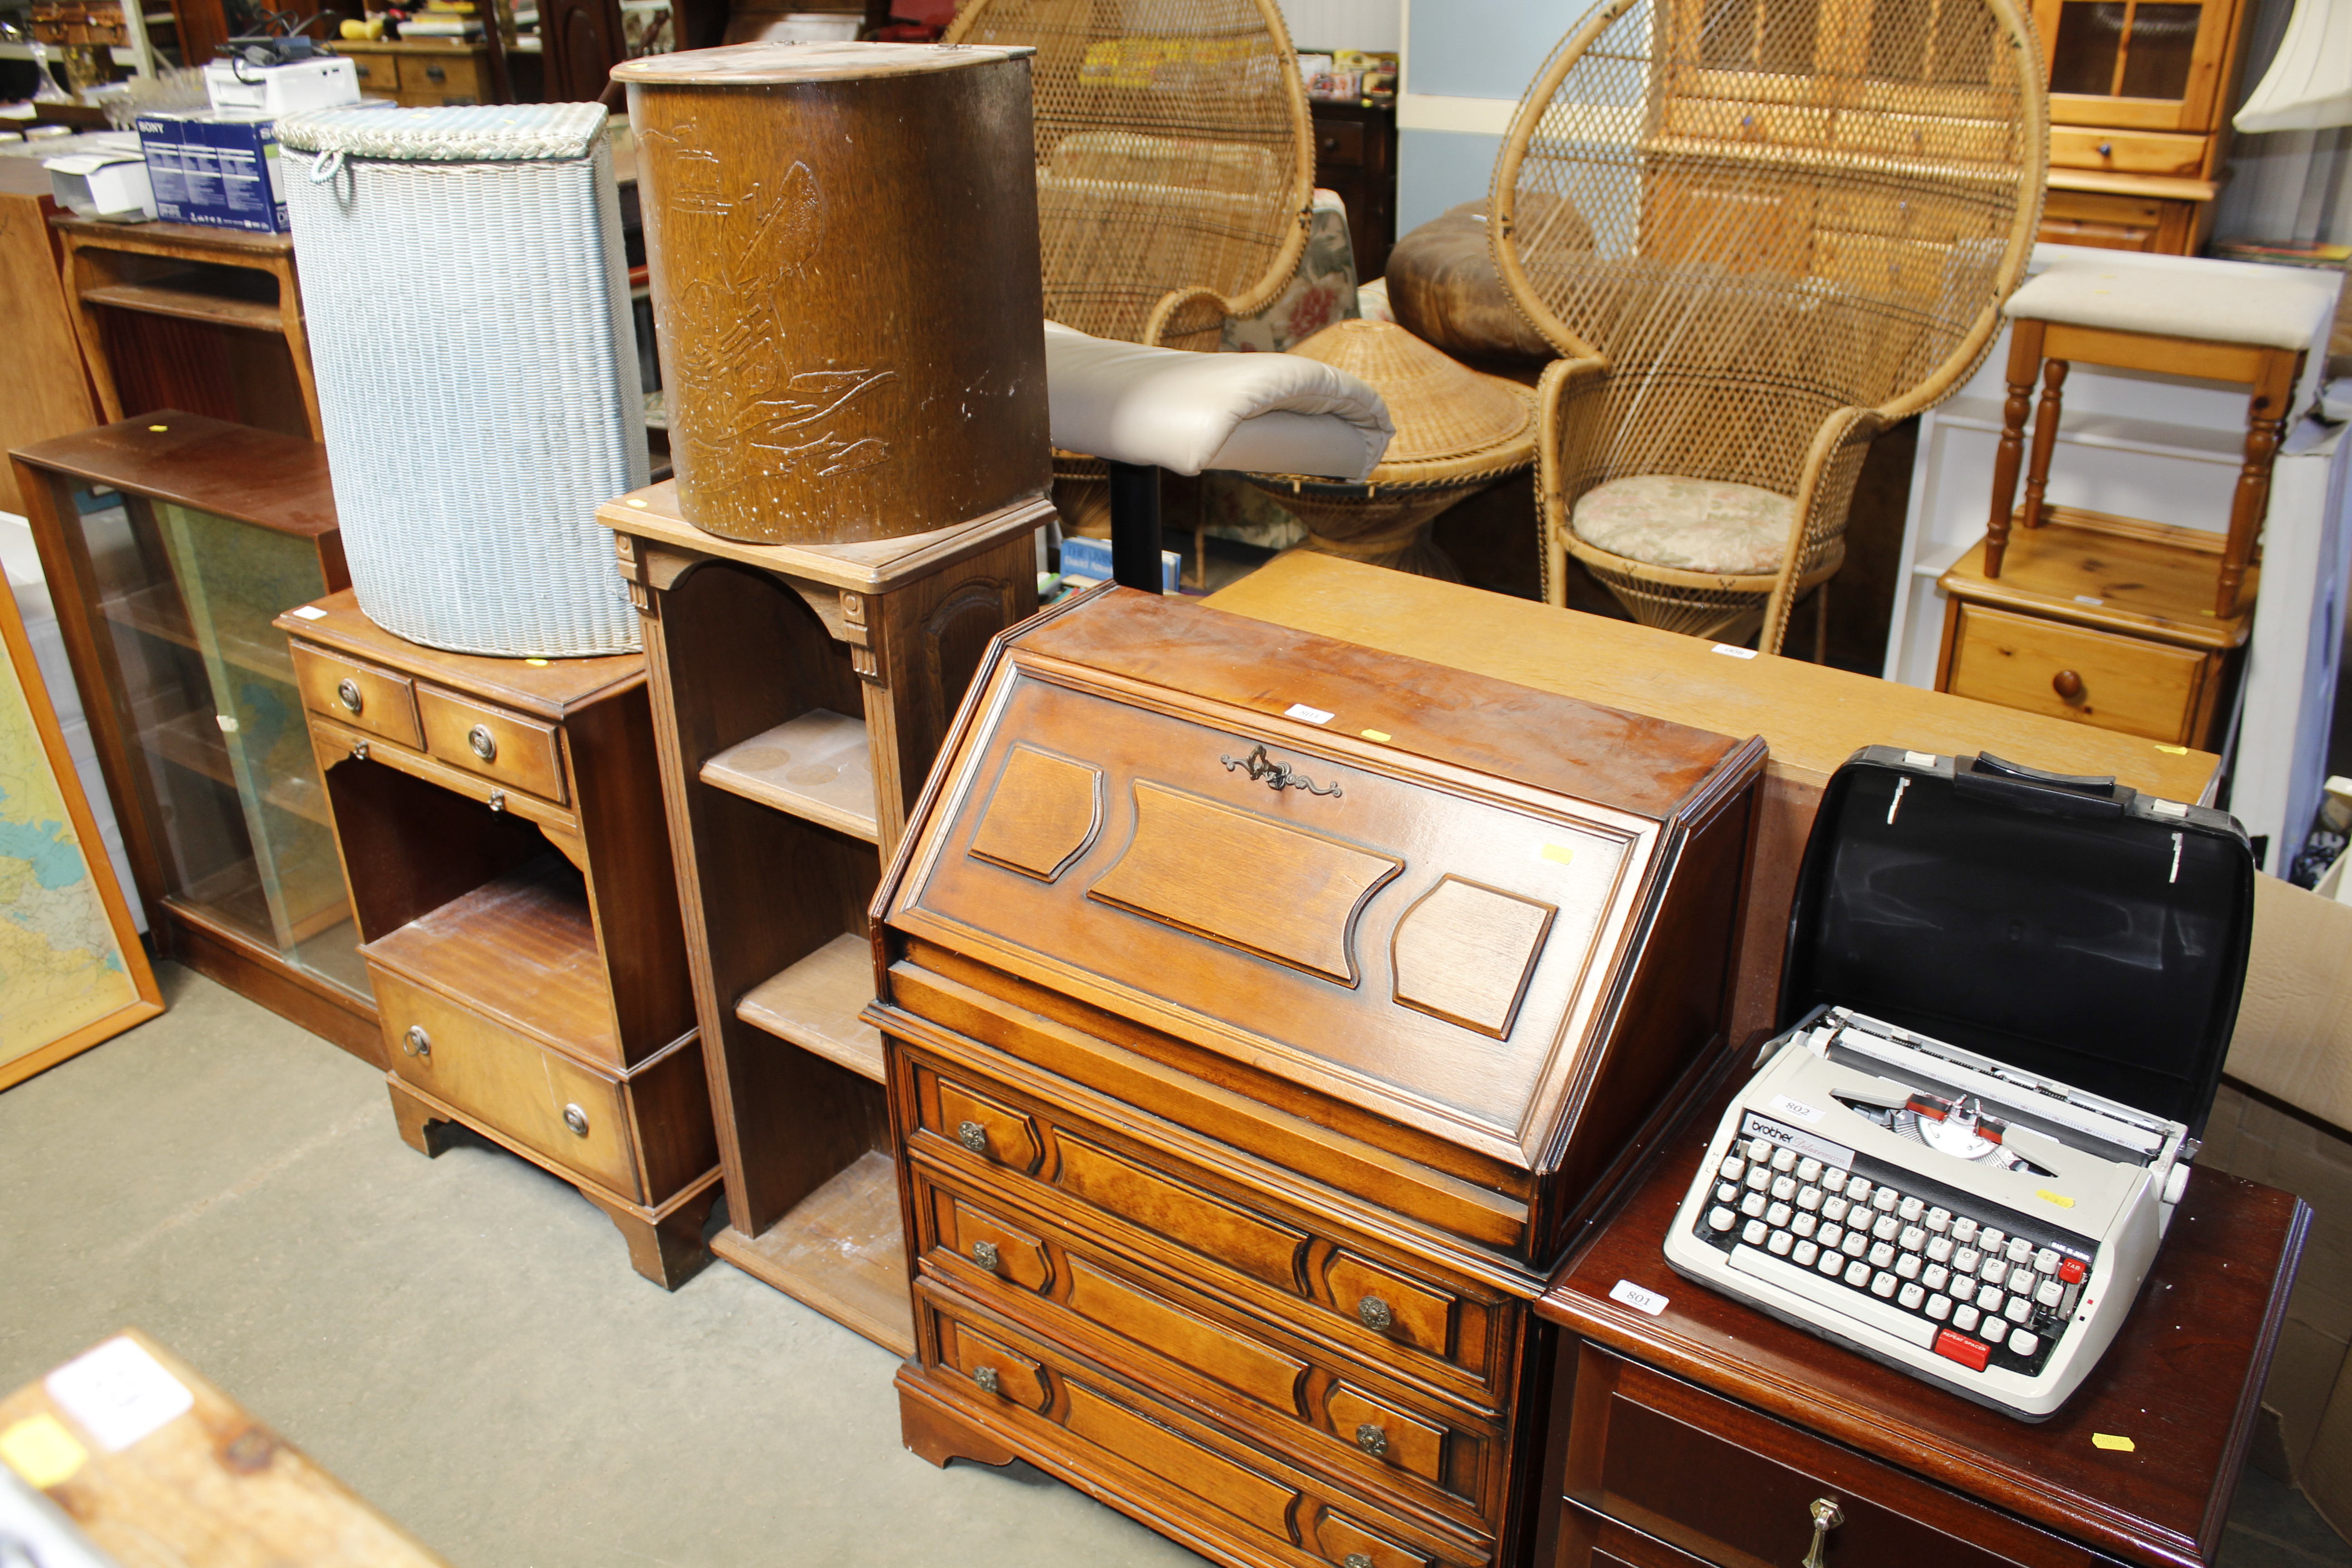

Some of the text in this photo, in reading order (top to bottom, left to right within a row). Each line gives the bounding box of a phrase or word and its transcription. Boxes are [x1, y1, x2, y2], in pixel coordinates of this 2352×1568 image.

[137, 121, 164, 134] SONY
[1785, 1102, 1810, 1115] 802
[1752, 1120, 1793, 1143] brother
[2052, 1241, 2067, 1252] MADE
[2073, 1251, 2090, 1261] JAPAN
[2067, 1262, 2081, 1270] TAB
[1627, 1291, 1651, 1306] 801
[1942, 1331, 1987, 1352] REPEAT SPACER
